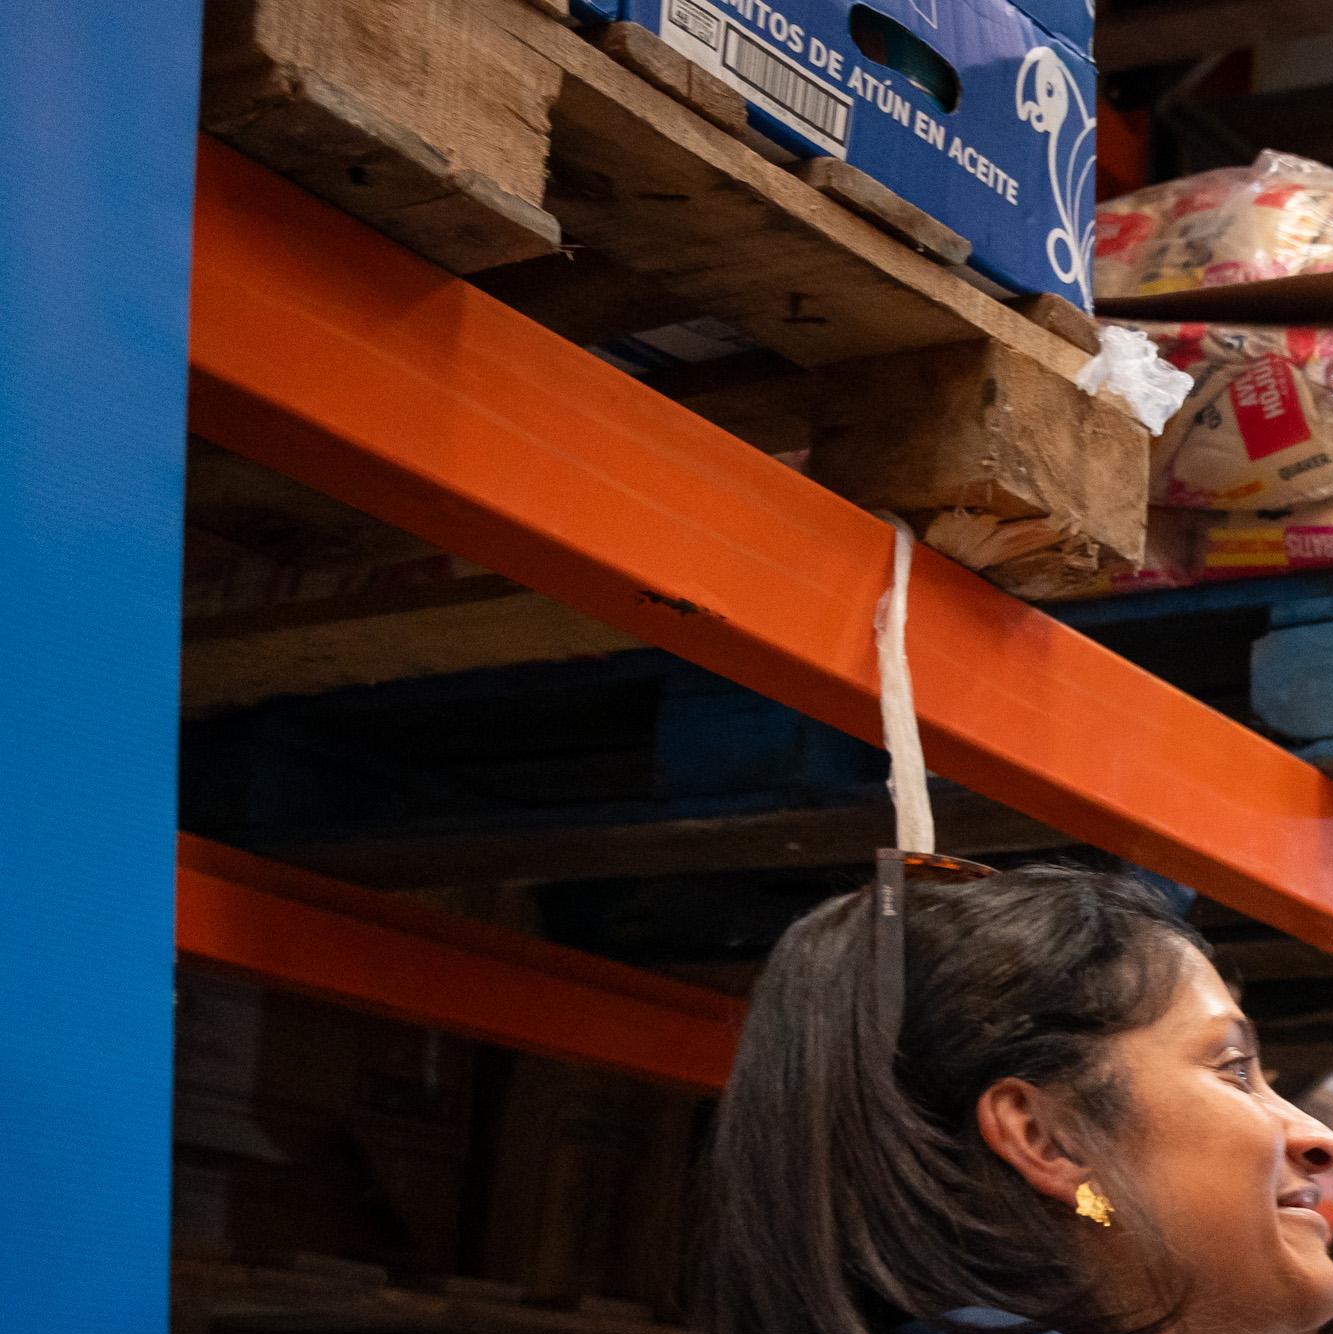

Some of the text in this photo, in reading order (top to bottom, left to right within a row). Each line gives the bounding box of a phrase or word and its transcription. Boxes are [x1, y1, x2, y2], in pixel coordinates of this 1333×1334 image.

[808, 37, 846, 82] DE
[847, 65, 912, 128] ATÚN
[914, 110, 946, 151] EN
[948, 136, 1020, 207] ACEITE
